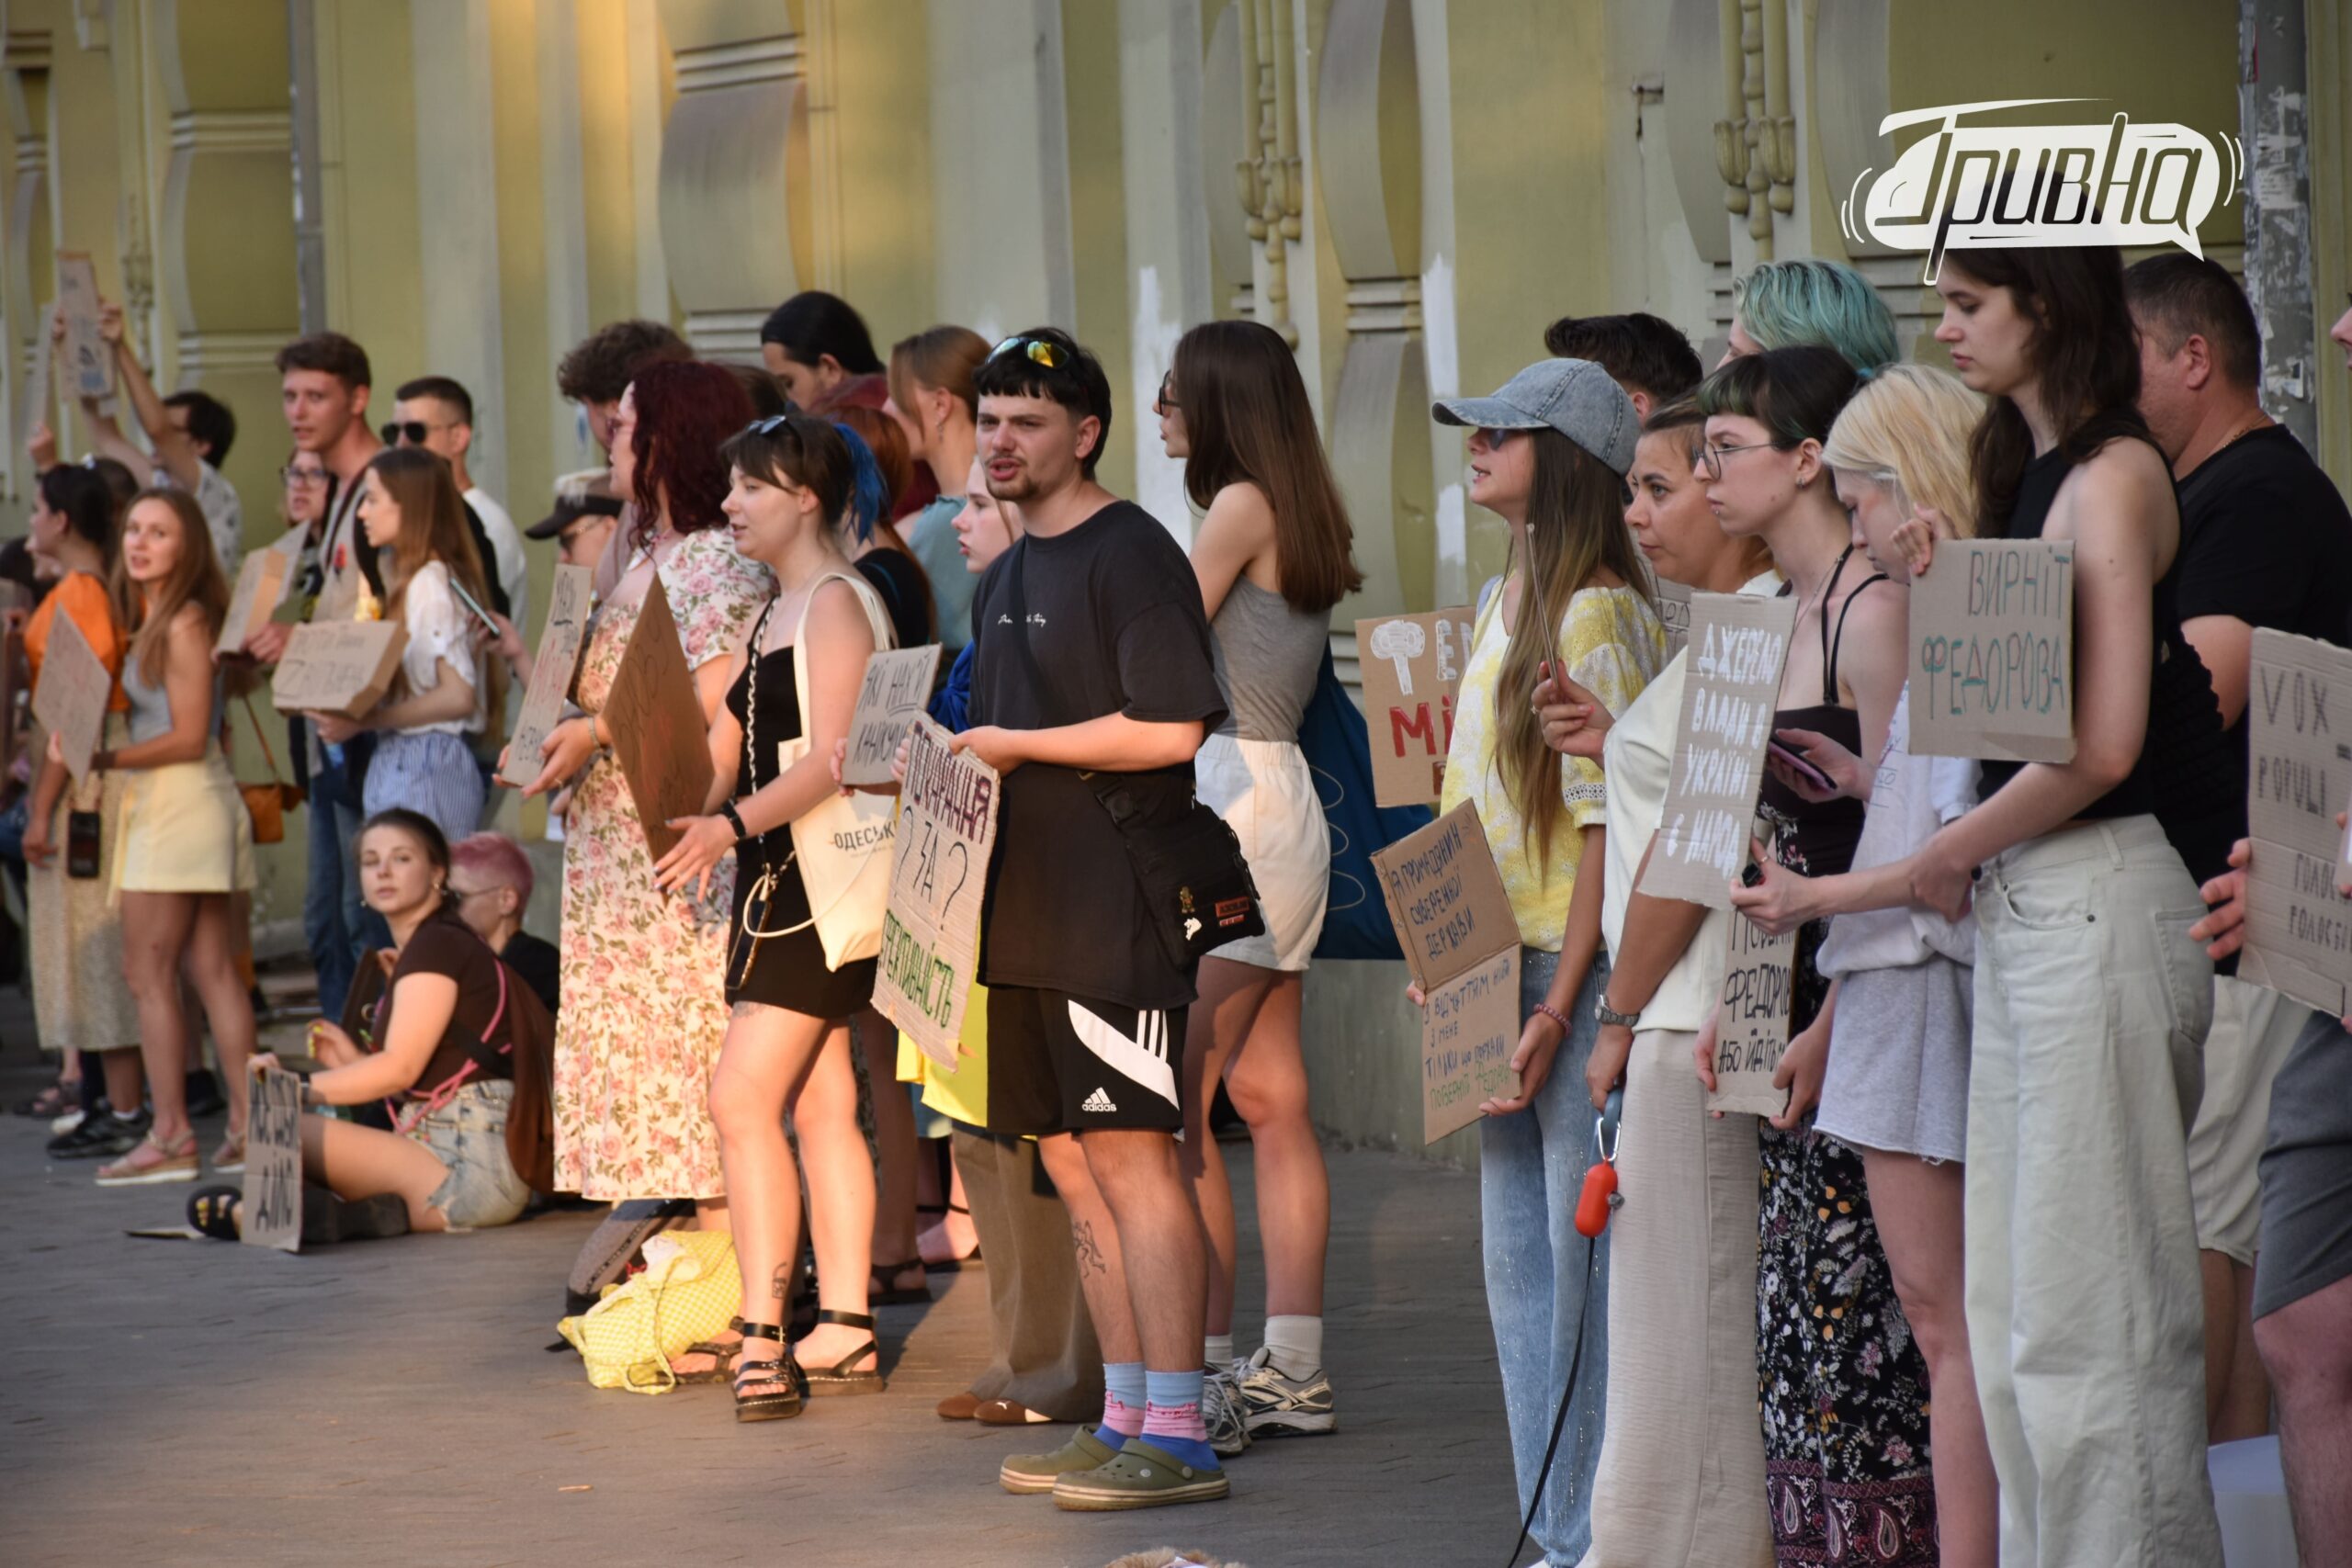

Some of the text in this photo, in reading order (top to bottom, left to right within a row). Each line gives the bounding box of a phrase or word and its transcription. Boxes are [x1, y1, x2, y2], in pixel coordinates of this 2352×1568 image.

[1698, 622, 1781, 685] ДЖЕРЕЛО
[1921, 631, 2064, 720] ФЕДОРОВА
[1691, 687, 1750, 746] ВЛАДИ
[2260, 667, 2330, 736] VOX
[905, 720, 991, 844] ПОКАРАННЯ
[1680, 743, 1752, 800] УКРАЇНІ
[2258, 756, 2325, 818] POPULI
[913, 820, 939, 903] ЗА
[1391, 821, 1463, 899] Я ГРОМАДЯНИН
[1684, 809, 1740, 880] НАРОД
[1410, 864, 1463, 926] СУВЕРЕННОЇ
[1426, 904, 1476, 962] ДЕРЖАВИ
[1475, 1057, 1513, 1096] ФЕДОРОВ
[1719, 1040, 1741, 1073] АБО
[1081, 1102, 1117, 1112] adidas
